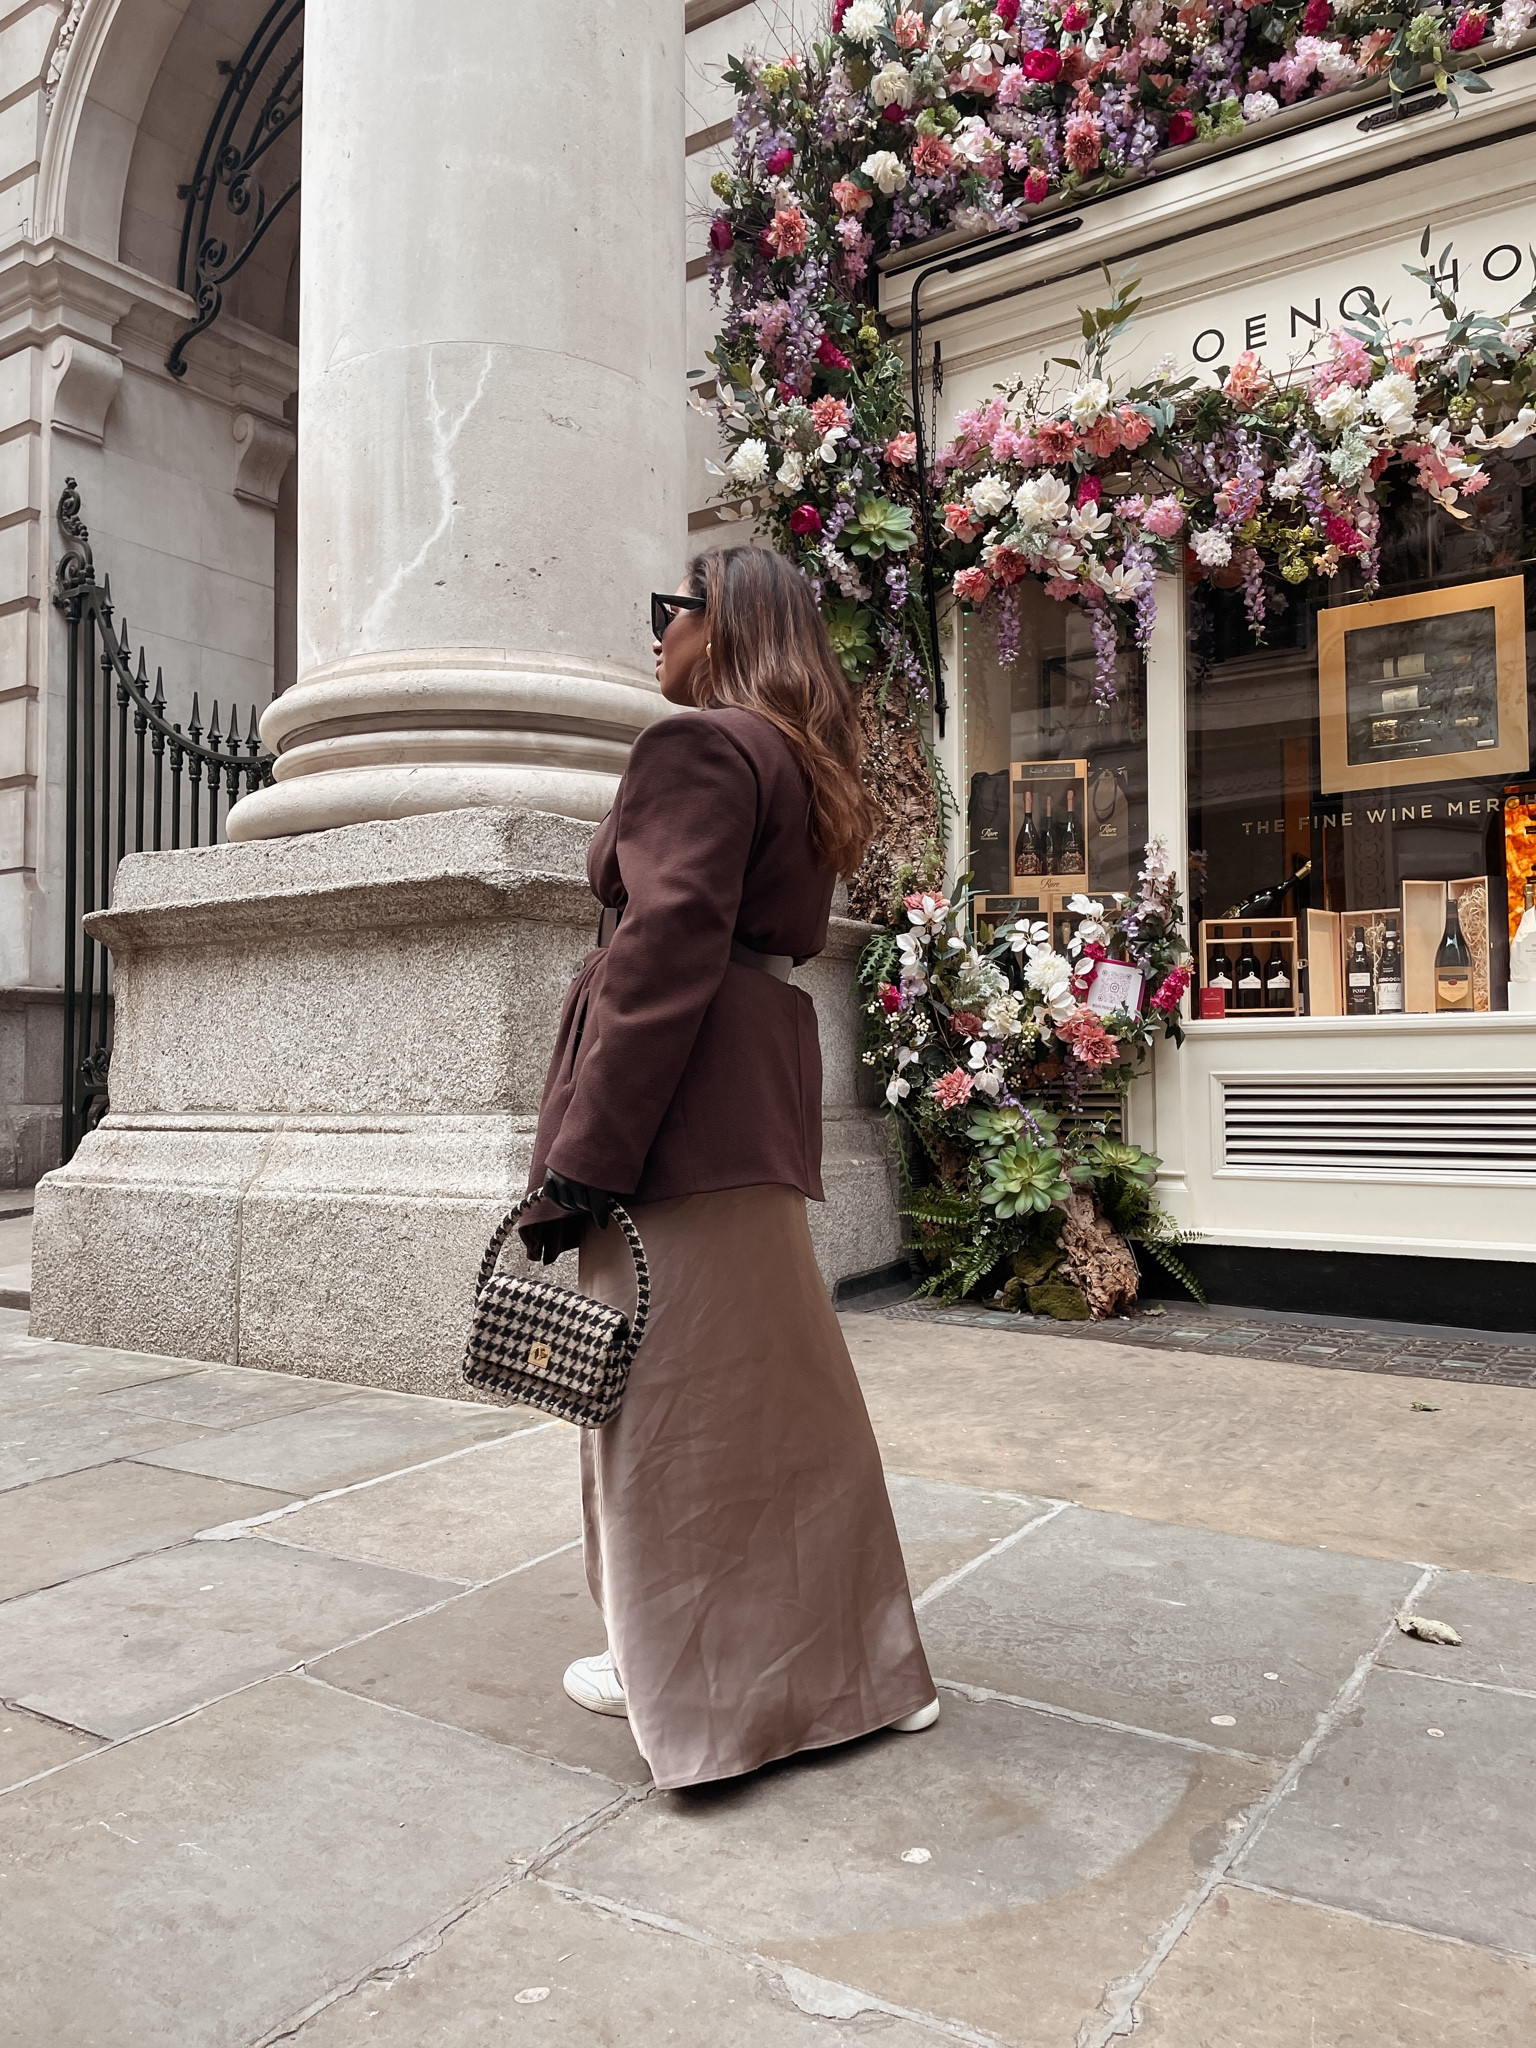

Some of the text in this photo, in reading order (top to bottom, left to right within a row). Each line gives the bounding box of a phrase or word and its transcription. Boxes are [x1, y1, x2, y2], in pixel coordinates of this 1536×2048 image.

[1193, 244, 1532, 363] OENO HO
[1242, 819, 1285, 835] THE
[1298, 812, 1352, 831] FINE
[1366, 804, 1432, 824] WINE
[1041, 878, 1060, 888] Rare
